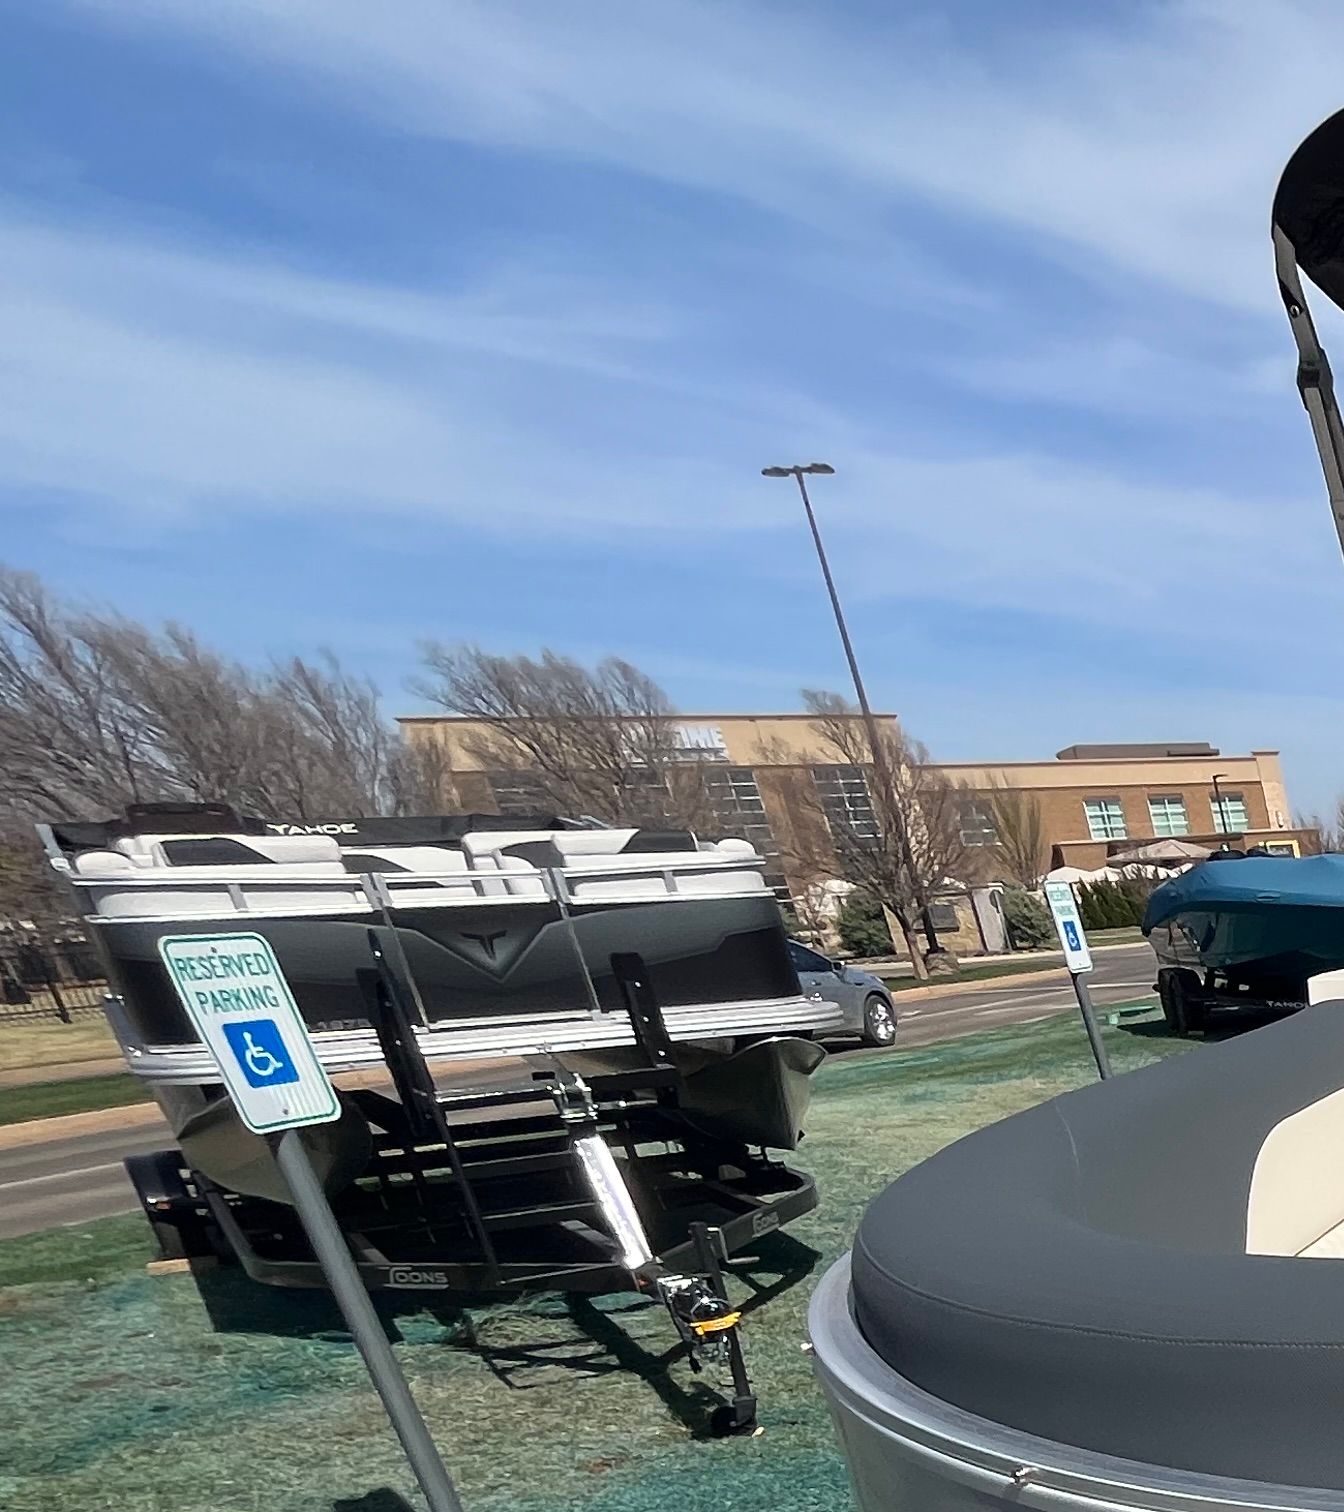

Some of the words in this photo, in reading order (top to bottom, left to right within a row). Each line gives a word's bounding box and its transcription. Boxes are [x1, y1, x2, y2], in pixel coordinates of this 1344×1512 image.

[266, 823, 359, 835] TAHOE
[174, 952, 270, 981] RESERVED
[195, 985, 280, 1015] PARKING
[1265, 1000, 1305, 1009] TAHO
